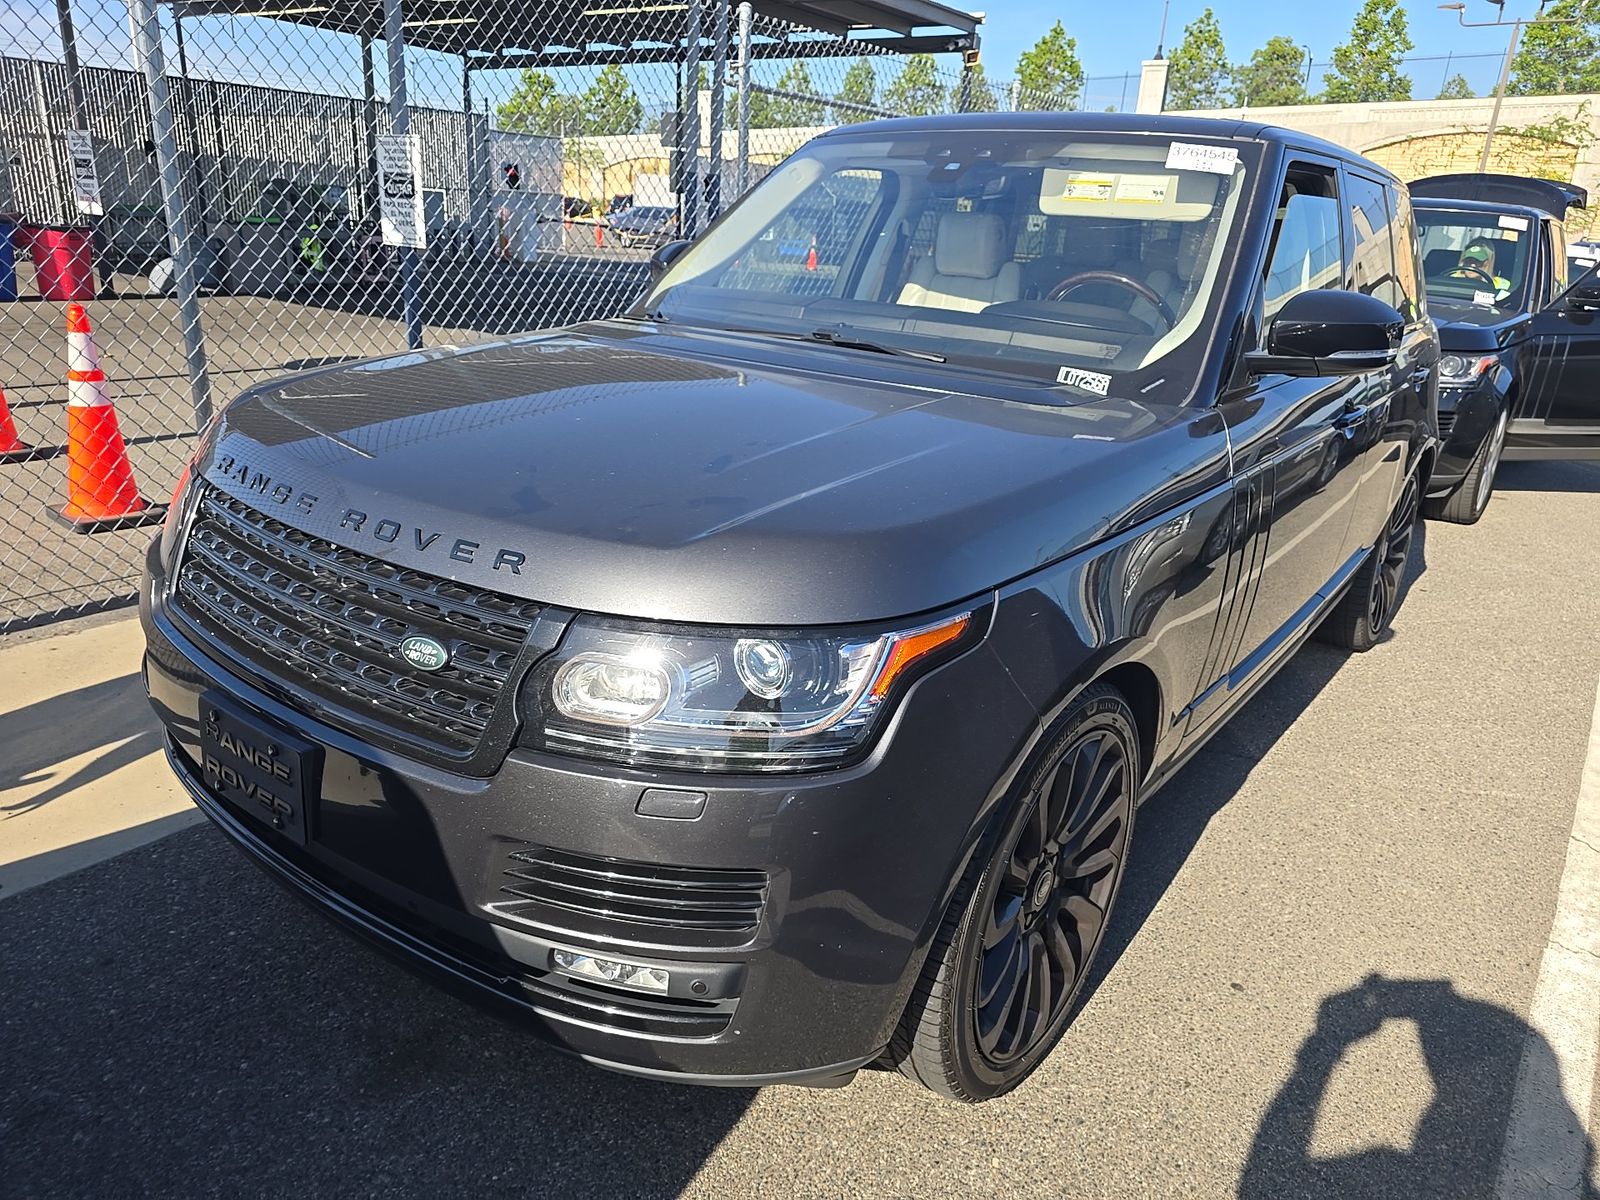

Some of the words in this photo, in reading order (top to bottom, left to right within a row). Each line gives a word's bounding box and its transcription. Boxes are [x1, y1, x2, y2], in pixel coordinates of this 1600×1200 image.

[1172, 146, 1236, 162] 3764545
[216, 453, 318, 515] RANGE
[340, 507, 527, 576] ROVER
[408, 649, 438, 666] ROVER
[409, 640, 433, 655] LAND
[205, 719, 292, 784] RANGE
[206, 754, 294, 818] ROVER
